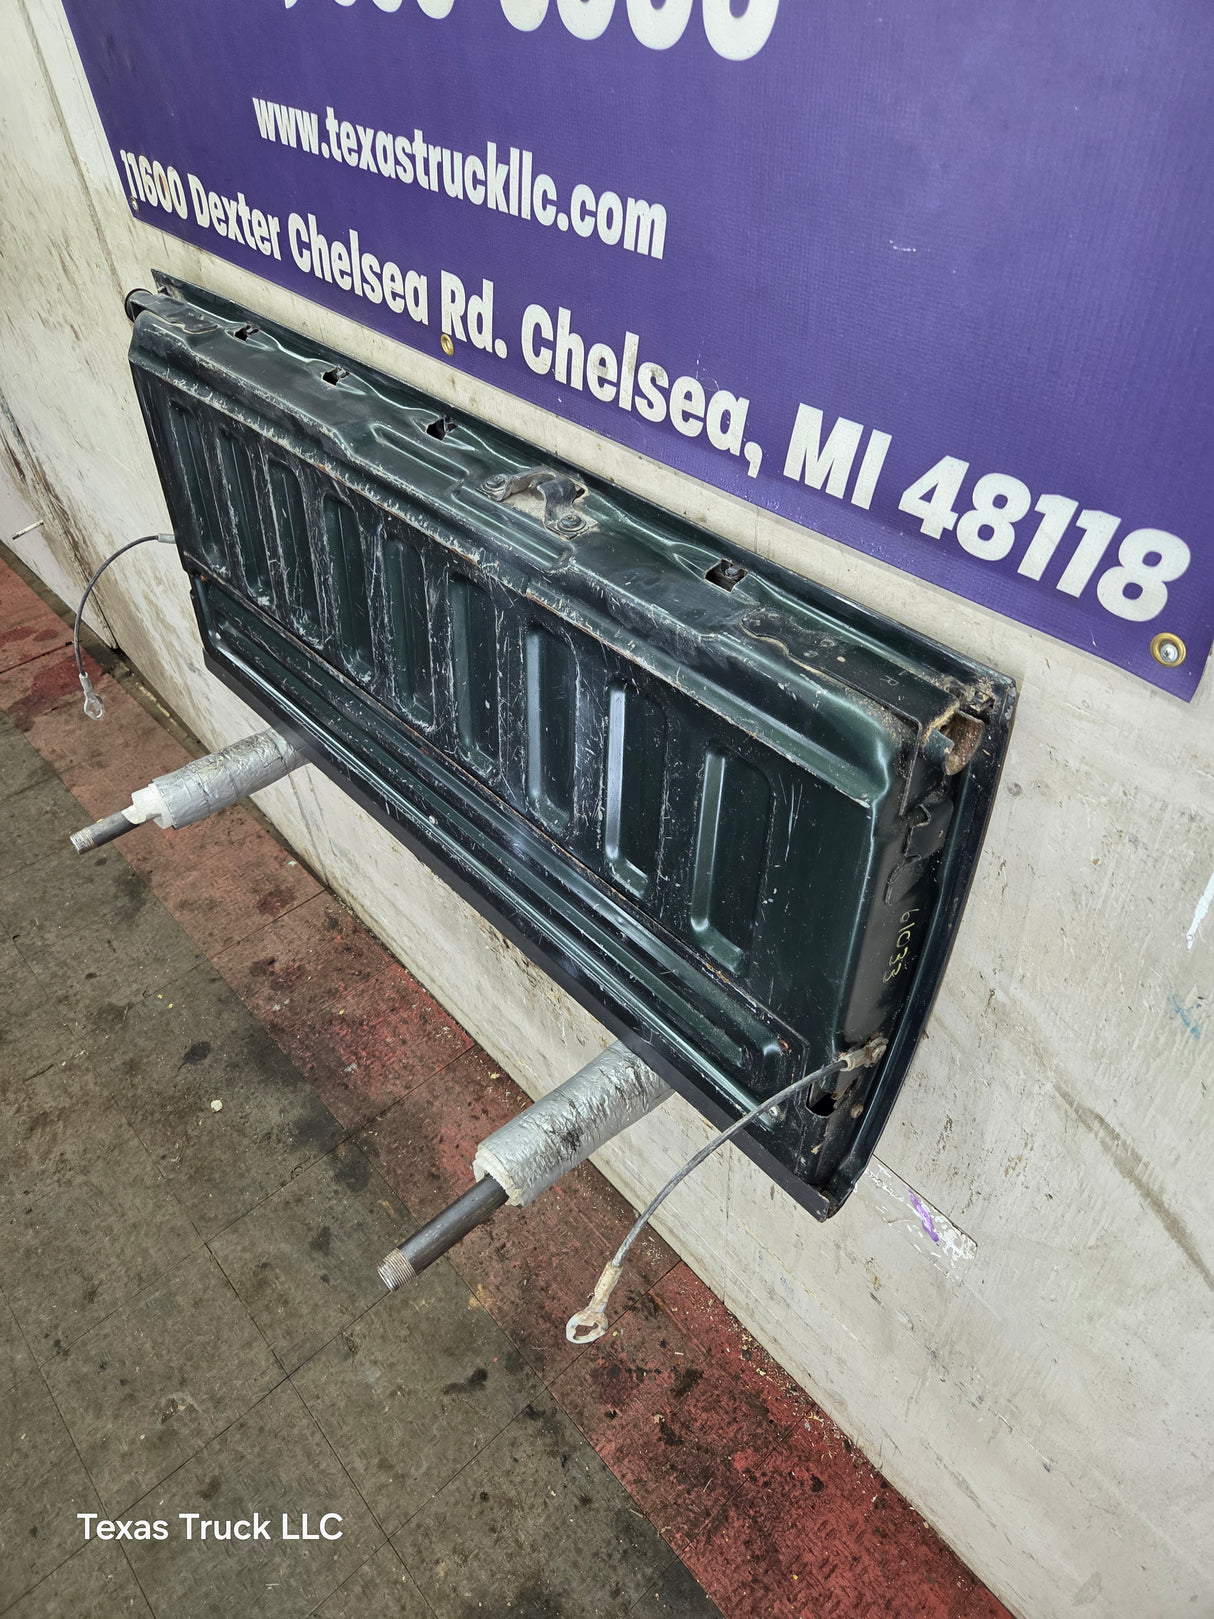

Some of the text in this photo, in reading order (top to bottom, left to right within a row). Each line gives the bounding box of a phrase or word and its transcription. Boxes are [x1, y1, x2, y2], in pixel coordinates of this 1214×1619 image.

[252, 97, 668, 260] www.texastruckllc.com
[120, 149, 1192, 622] 11600 Dexter Chelsea Rd. Chelsea, MI 48118
[883, 908, 920, 984] 61033
